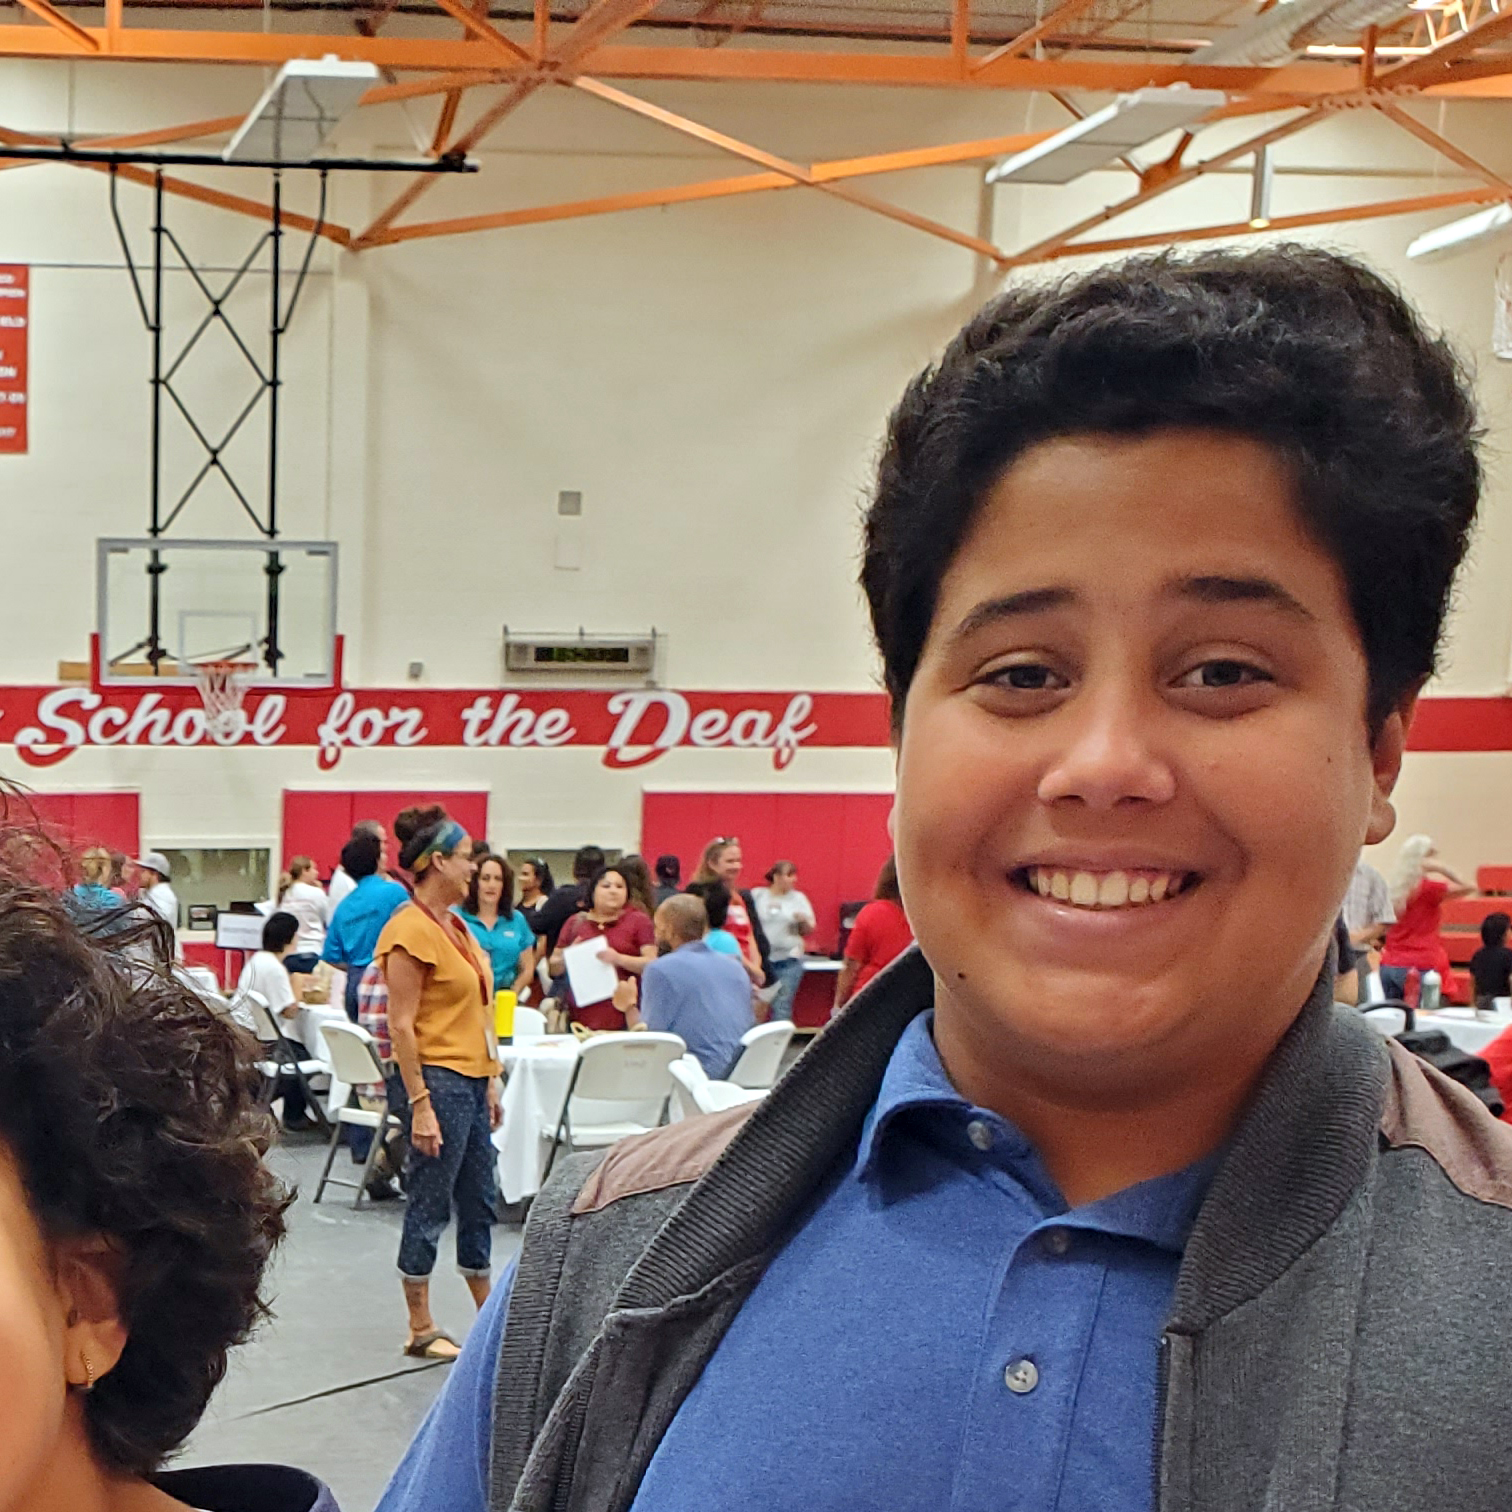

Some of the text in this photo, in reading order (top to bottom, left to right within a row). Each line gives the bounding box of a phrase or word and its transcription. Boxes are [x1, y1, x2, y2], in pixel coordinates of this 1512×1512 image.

[15, 688, 287, 767] School
[317, 692, 428, 770] for
[462, 694, 576, 747] the
[602, 690, 818, 770] Deaf
